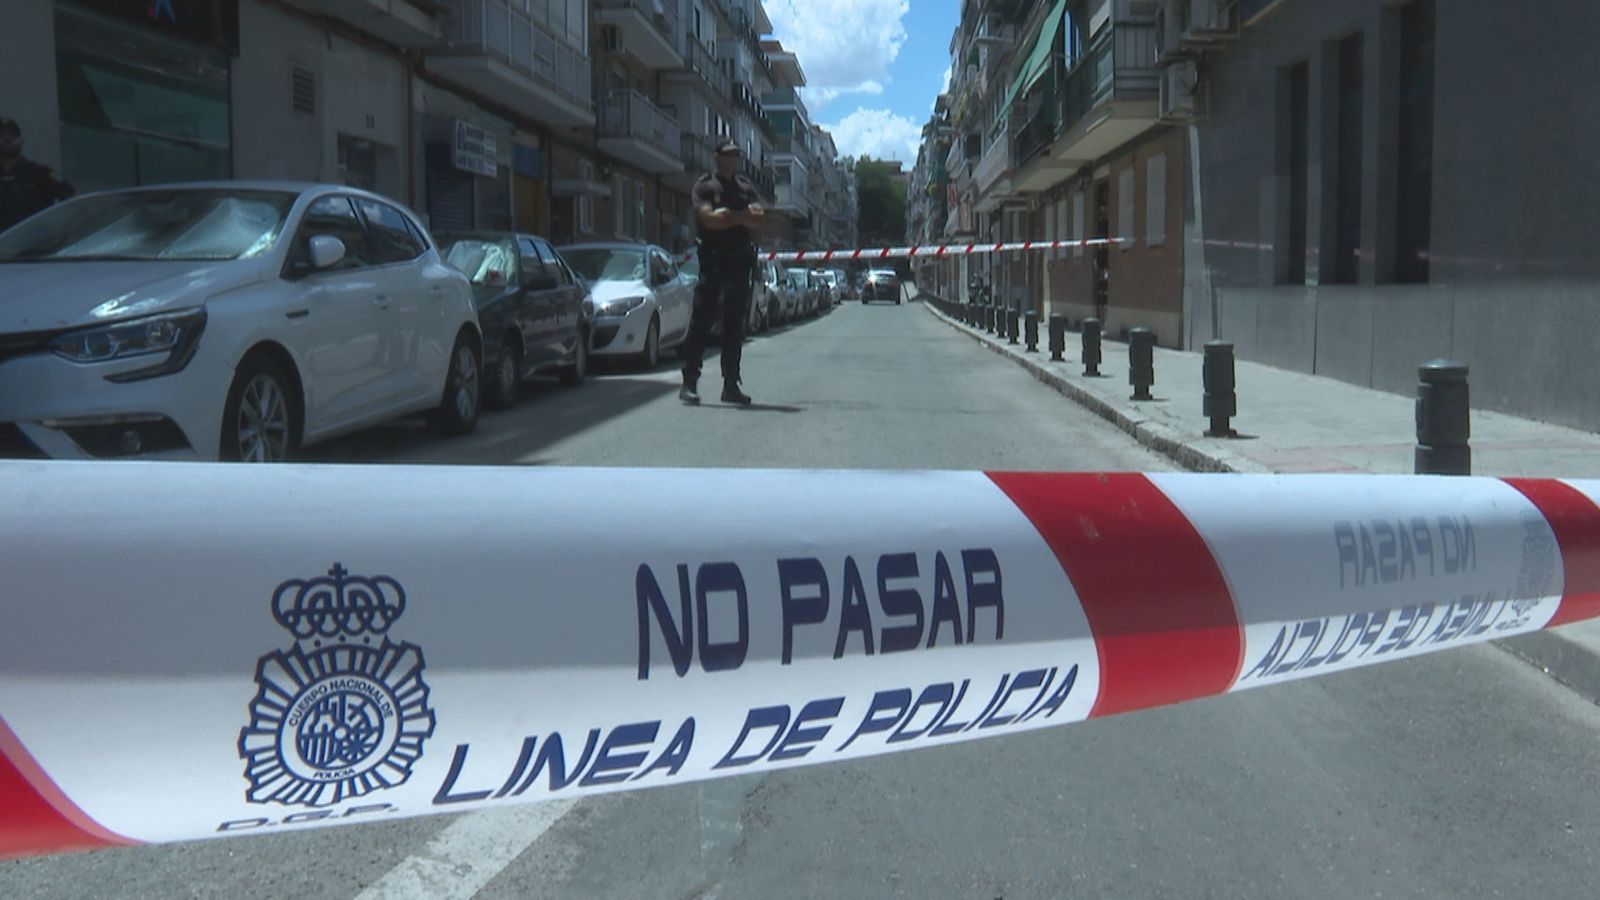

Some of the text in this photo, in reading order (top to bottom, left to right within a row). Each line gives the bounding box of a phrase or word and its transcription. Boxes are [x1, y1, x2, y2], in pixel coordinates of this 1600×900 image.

[635, 548, 1005, 680] NO PASAR
[288, 679, 394, 727] CUERPO NACIONAL DE
[432, 663, 1079, 805] LINEA DE POLICIA
